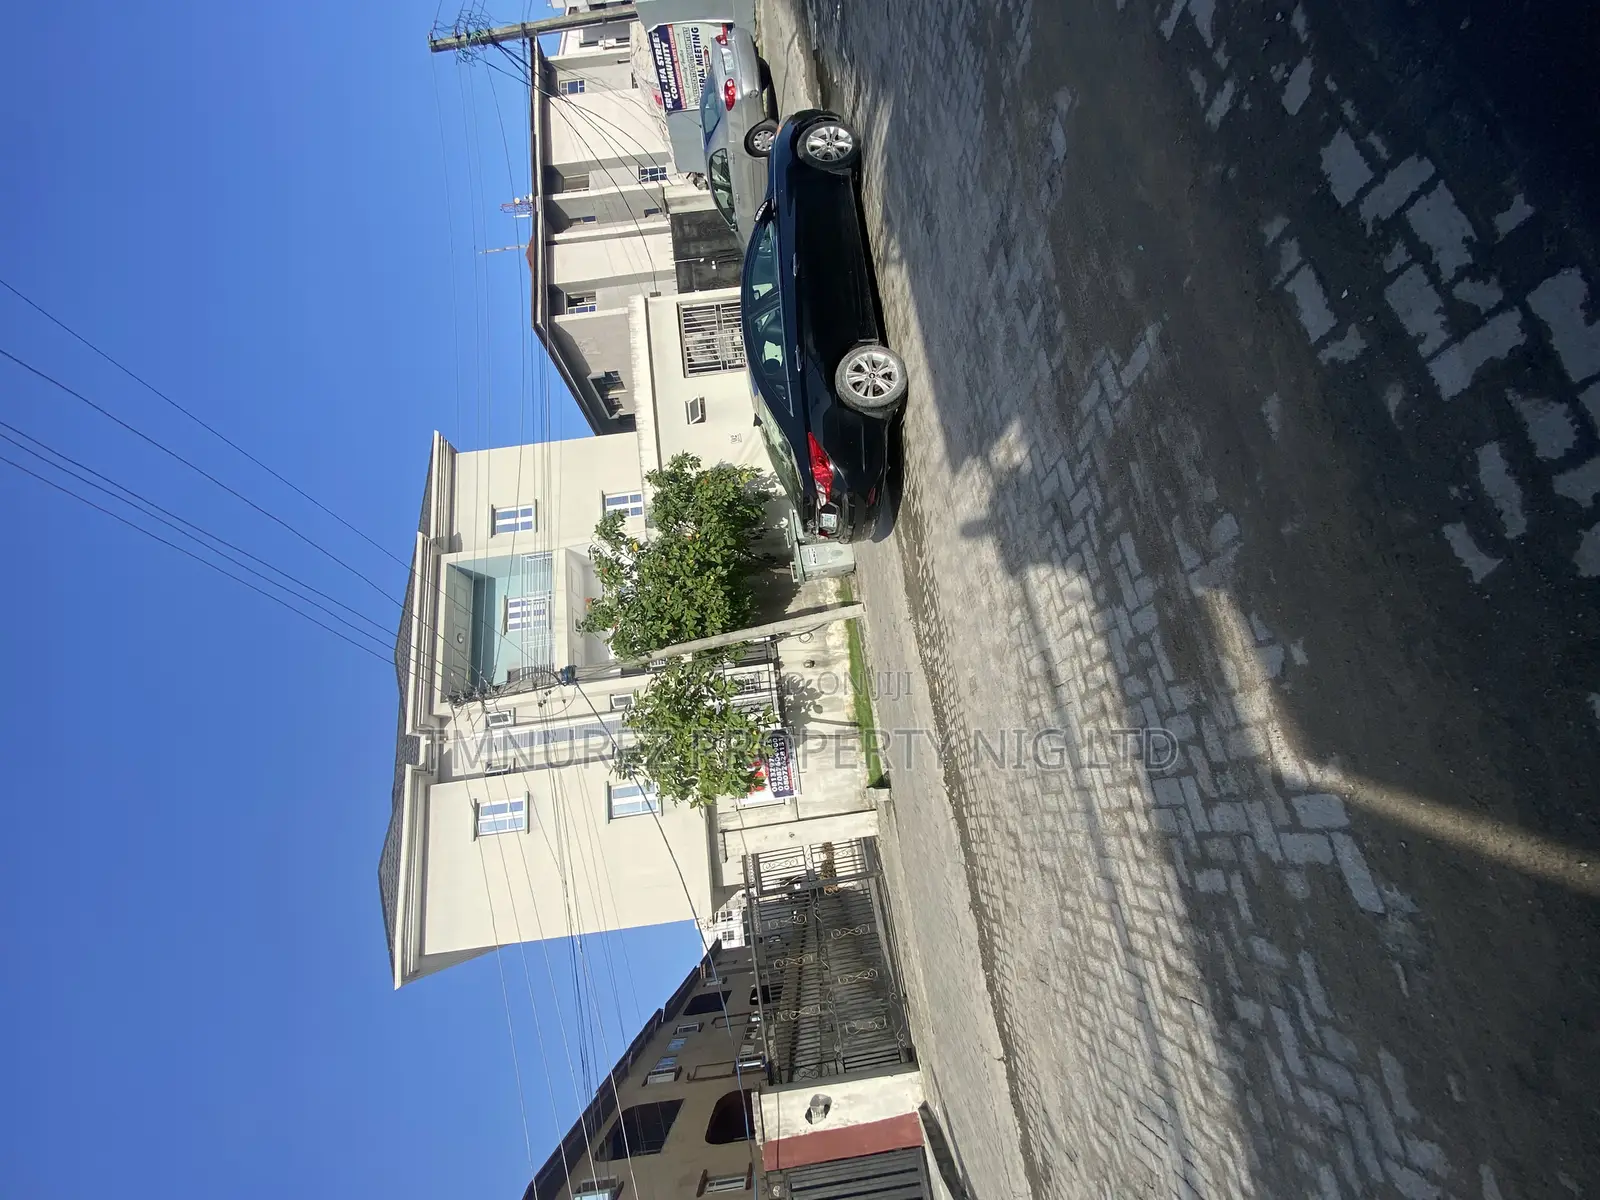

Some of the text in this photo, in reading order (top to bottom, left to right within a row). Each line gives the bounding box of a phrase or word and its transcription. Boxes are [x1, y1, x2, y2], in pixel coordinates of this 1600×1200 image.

[650, 32, 665, 67] STREET
[691, 27, 704, 67] MEETING
[659, 67, 668, 83] IFA
[661, 41, 678, 99] COMMUNITY
